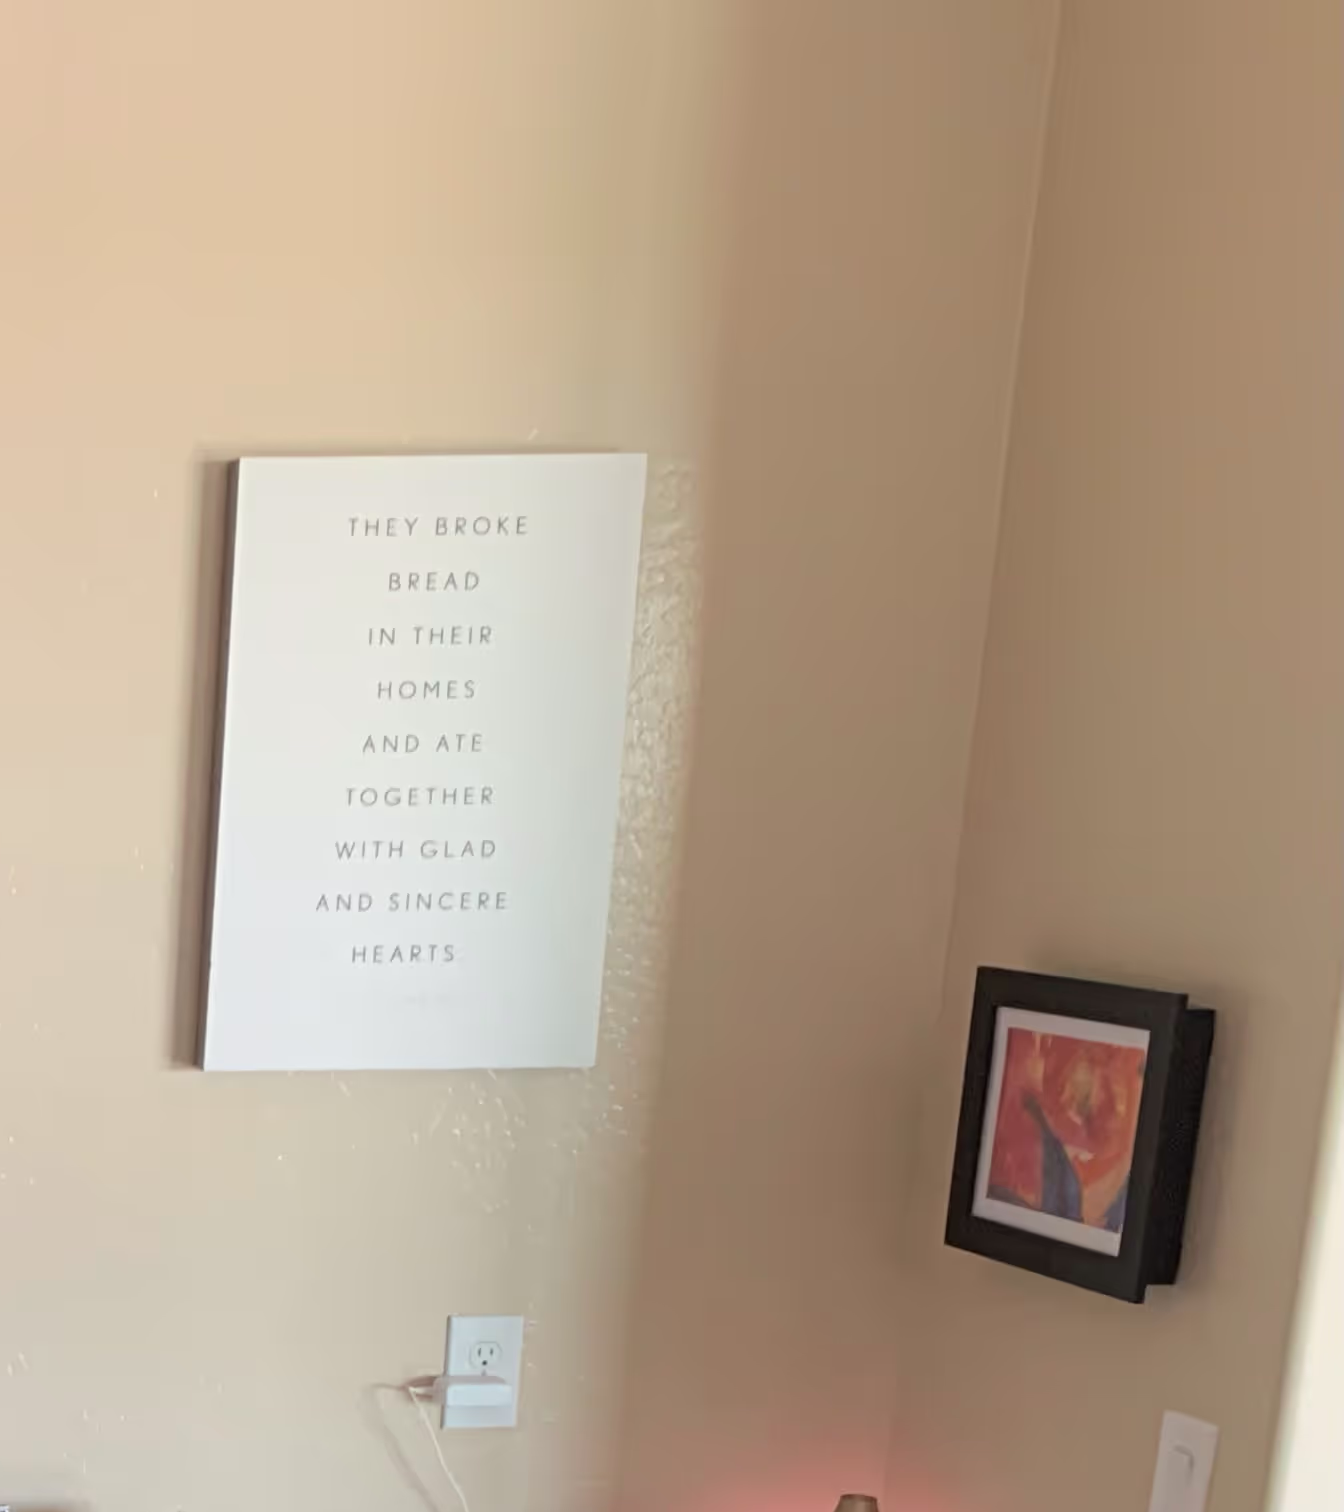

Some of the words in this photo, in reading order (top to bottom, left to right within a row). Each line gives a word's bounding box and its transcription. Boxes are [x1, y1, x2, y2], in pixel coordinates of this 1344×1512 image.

[348, 516, 419, 538] THEY
[435, 515, 528, 538] BROKE
[388, 570, 481, 593] BREAD
[367, 626, 397, 647] IN
[412, 625, 493, 646] THEIR
[377, 679, 476, 701] HOMES
[361, 733, 421, 755] AND
[434, 733, 484, 754] ATE
[345, 785, 495, 808] TOGETHER
[334, 839, 405, 861] WITH
[418, 839, 497, 860] GLAD
[315, 892, 374, 913] AND
[387, 891, 509, 913] SINCERE
[351, 943, 456, 965] HEARTS
